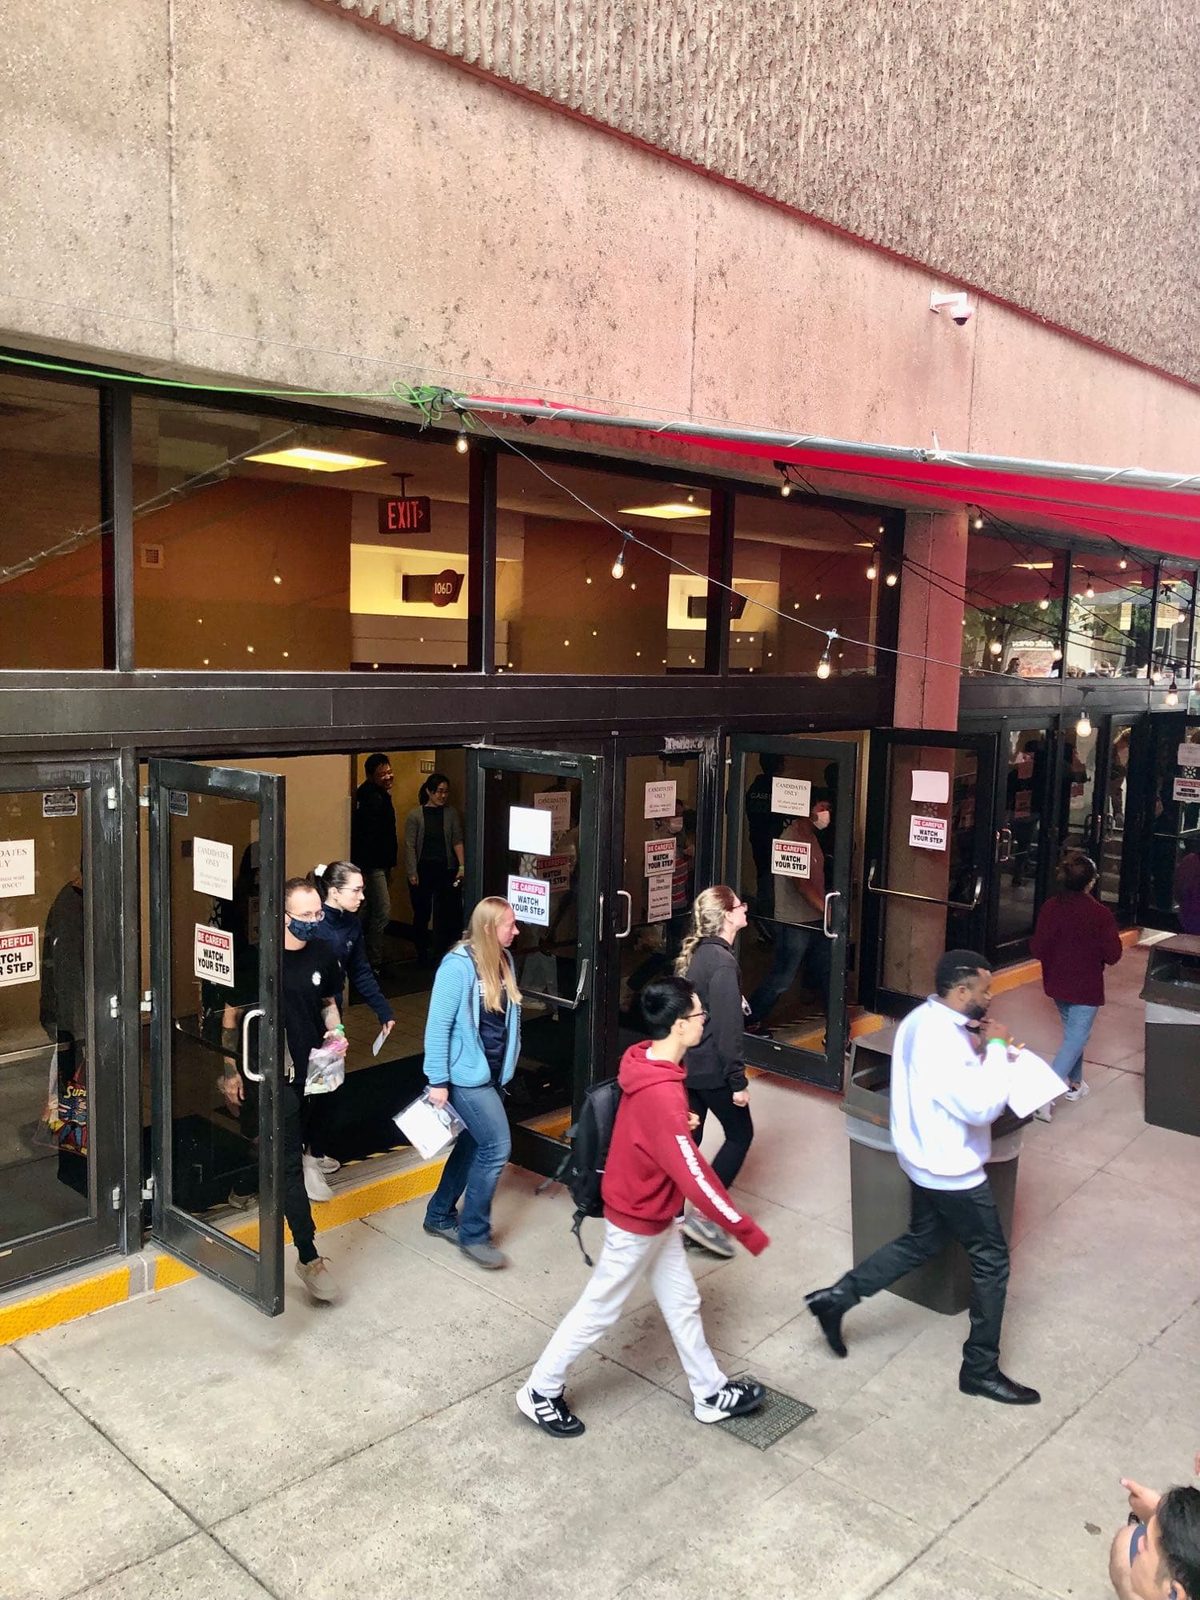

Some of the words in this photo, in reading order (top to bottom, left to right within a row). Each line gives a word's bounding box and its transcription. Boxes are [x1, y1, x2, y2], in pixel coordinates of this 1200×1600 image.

[388, 501, 418, 529] EXIT
[434, 582, 453, 595] 106D
[776, 782, 808, 791] CANDIDATES
[784, 789, 798, 797] ONLY
[922, 821, 945, 829] CAREFUL
[919, 829, 939, 837] WATCH
[654, 842, 674, 851] CAREFUL
[783, 845, 808, 854] CAREFUL
[652, 853, 669, 861] WATCH
[780, 854, 801, 863] WATCH
[648, 861, 661, 870] YOUR
[661, 859, 674, 867] STEP
[774, 860, 791, 869] YOUR
[791, 863, 807, 871] STEP
[512, 881, 520, 890] BE
[519, 883, 546, 896] CAREFUL
[517, 895, 539, 906] WATCH
[511, 902, 529, 913] YOUR
[529, 906, 546, 916] STEP
[198, 932, 206, 943] BE
[204, 934, 230, 949] CAREFUL
[202, 949, 224, 962] WATCH
[6, 961, 34, 974] STEP
[197, 957, 214, 970] YOUR
[215, 963, 230, 974] STEP
